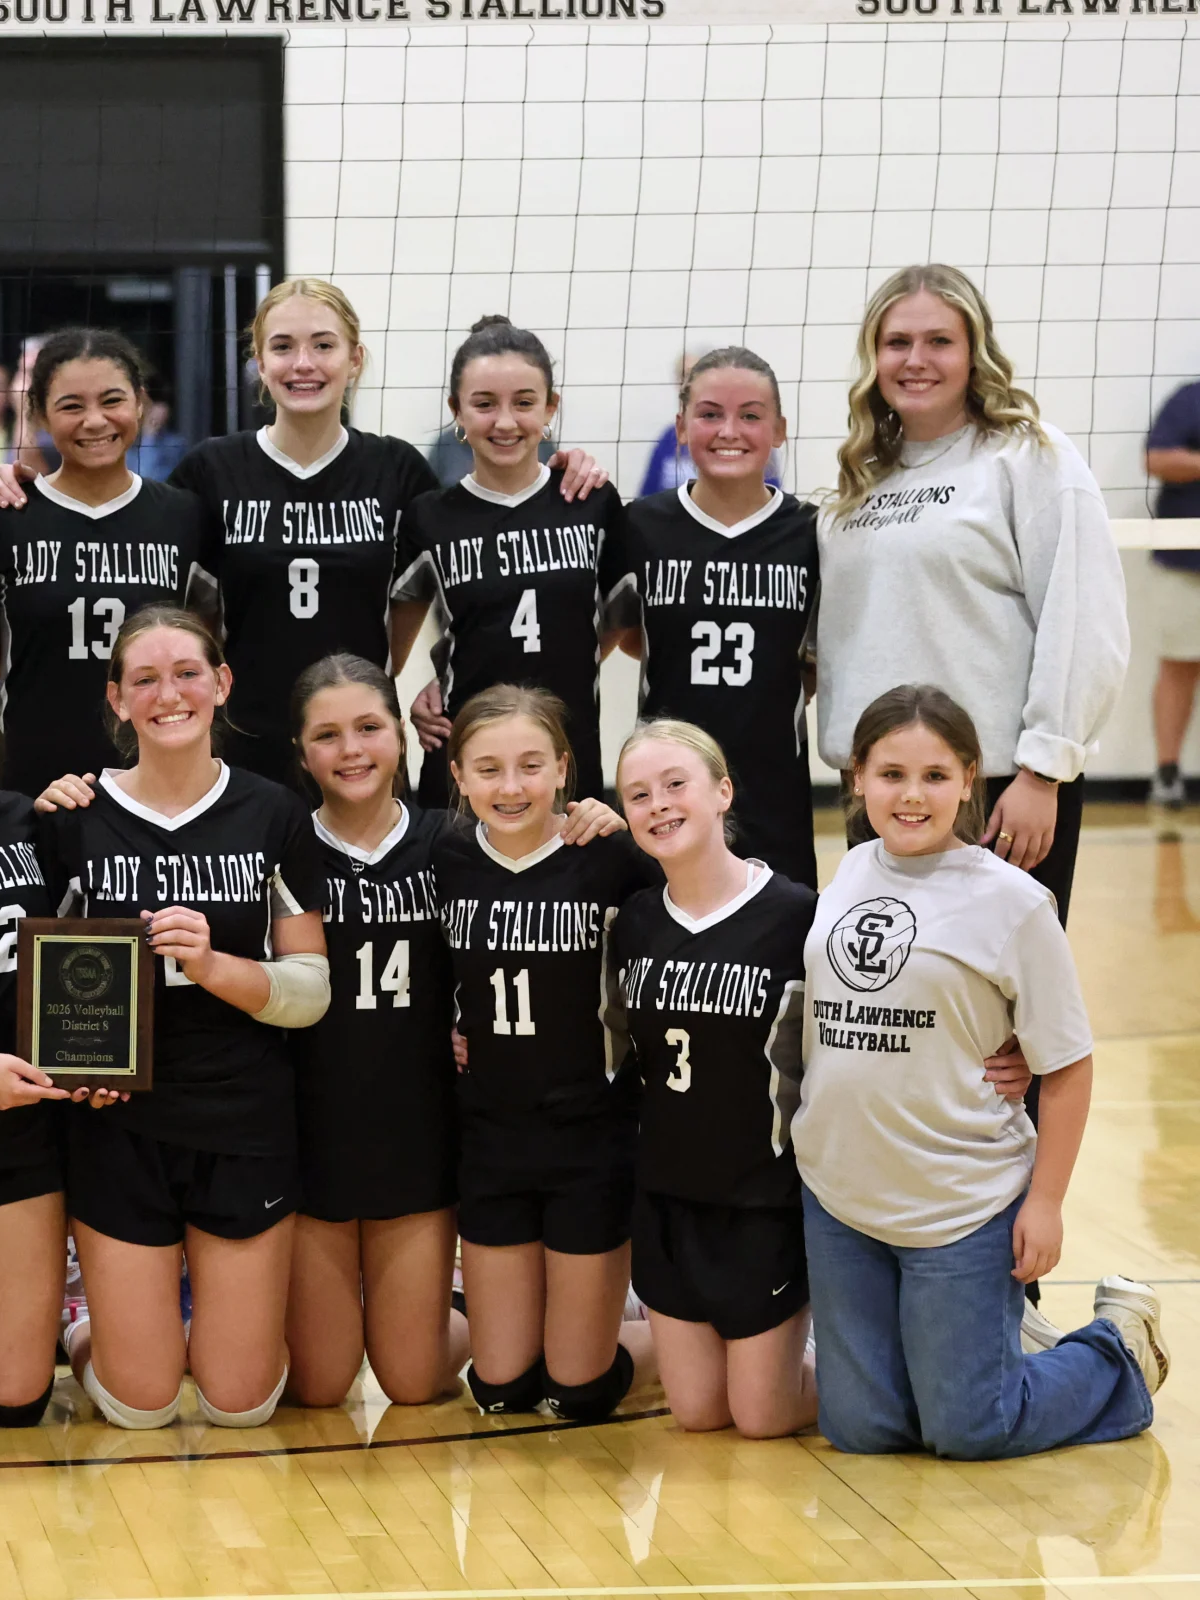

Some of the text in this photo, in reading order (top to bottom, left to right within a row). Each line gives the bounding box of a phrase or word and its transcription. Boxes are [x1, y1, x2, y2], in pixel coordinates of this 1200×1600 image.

[150, 0, 411, 23] LAWRENCE
[223, 497, 385, 545] LADY STALLIONS
[872, 486, 955, 511] STALLIONS
[12, 540, 179, 591] LADY STALLIONS
[435, 523, 596, 589] LADY STALLIONS
[288, 557, 320, 619] 8
[645, 559, 808, 612] LADY STALLIONS
[67, 596, 126, 660] 13
[509, 588, 541, 654] 4
[690, 620, 756, 687] 23
[87, 851, 265, 903] LADY STALLIONS
[487, 900, 600, 952] STALLIONS
[355, 939, 411, 1010] 14
[655, 959, 771, 1018] STALLIONS
[46, 1003, 125, 1018] 2026 Volleyball
[61, 1019, 109, 1031] District 8
[489, 967, 536, 1036] 11
[813, 999, 937, 1029] OUTH LAWRENCE
[55, 1050, 114, 1064] Champions
[664, 1027, 692, 1093] 3
[818, 1021, 911, 1053] VOLLEYBALL
